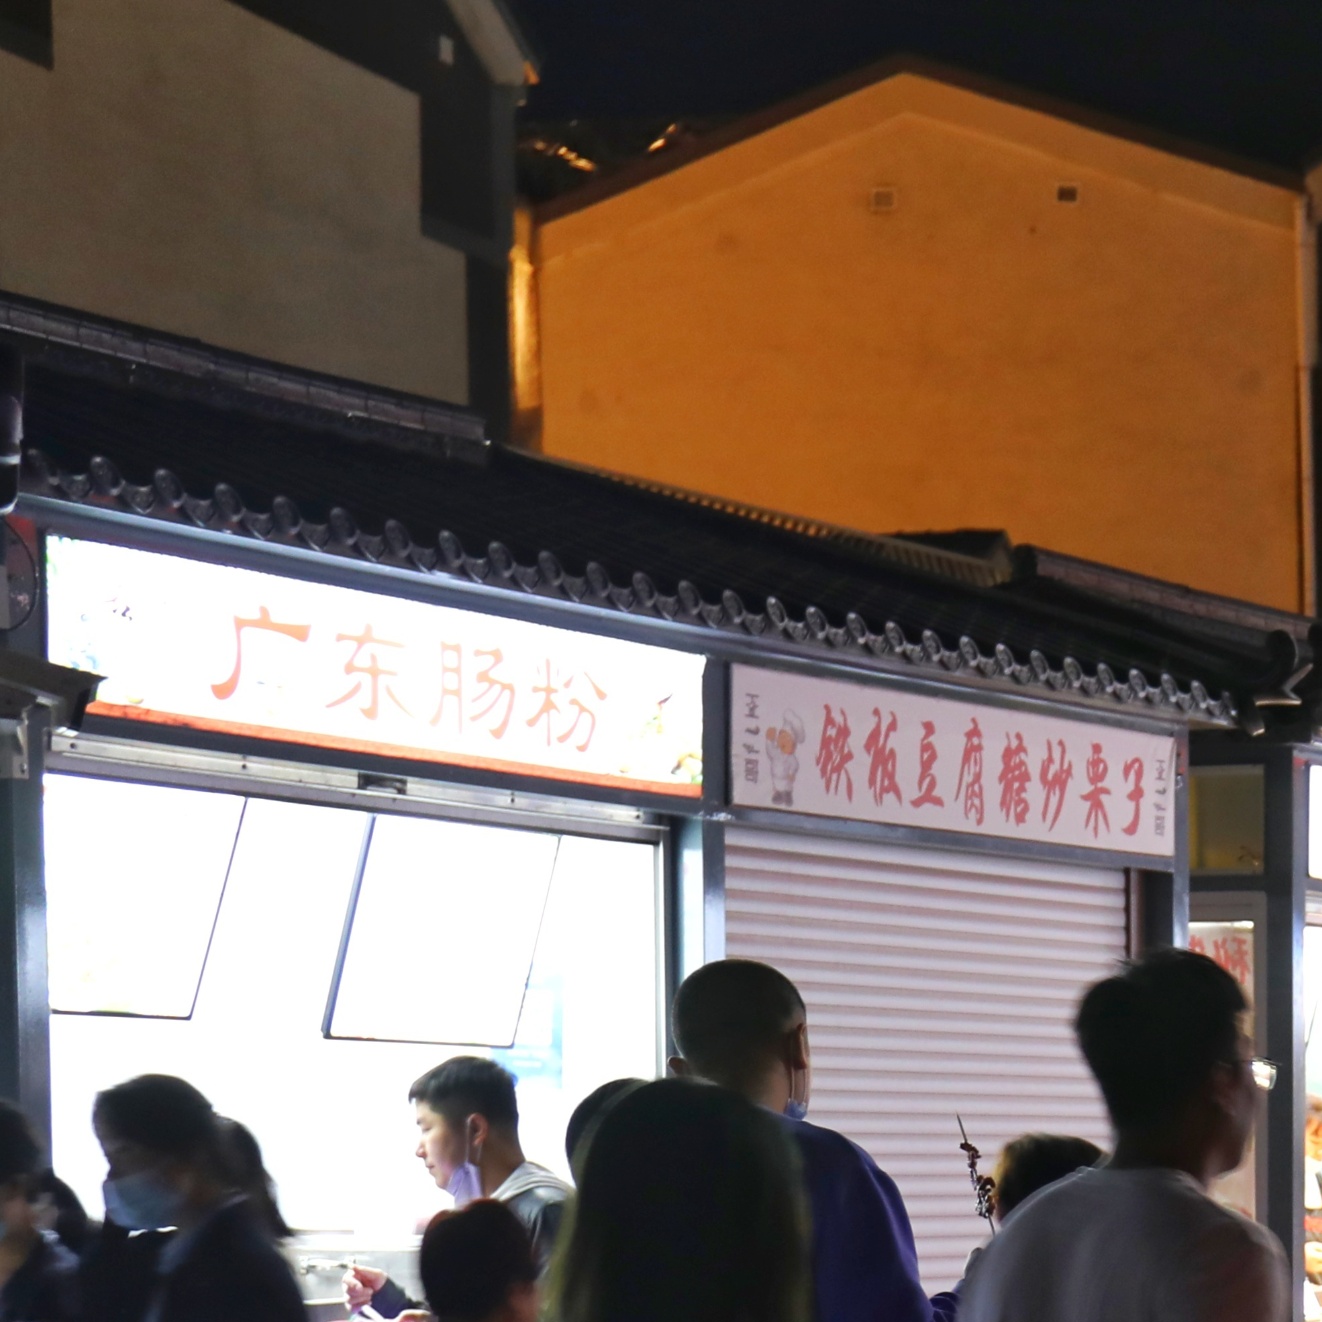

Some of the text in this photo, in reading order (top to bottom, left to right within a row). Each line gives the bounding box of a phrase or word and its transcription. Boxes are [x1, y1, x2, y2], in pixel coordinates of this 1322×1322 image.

[211, 606, 608, 753] 广东肠粉
[816, 703, 1145, 839] 铁板豆腐糖炒栗子
